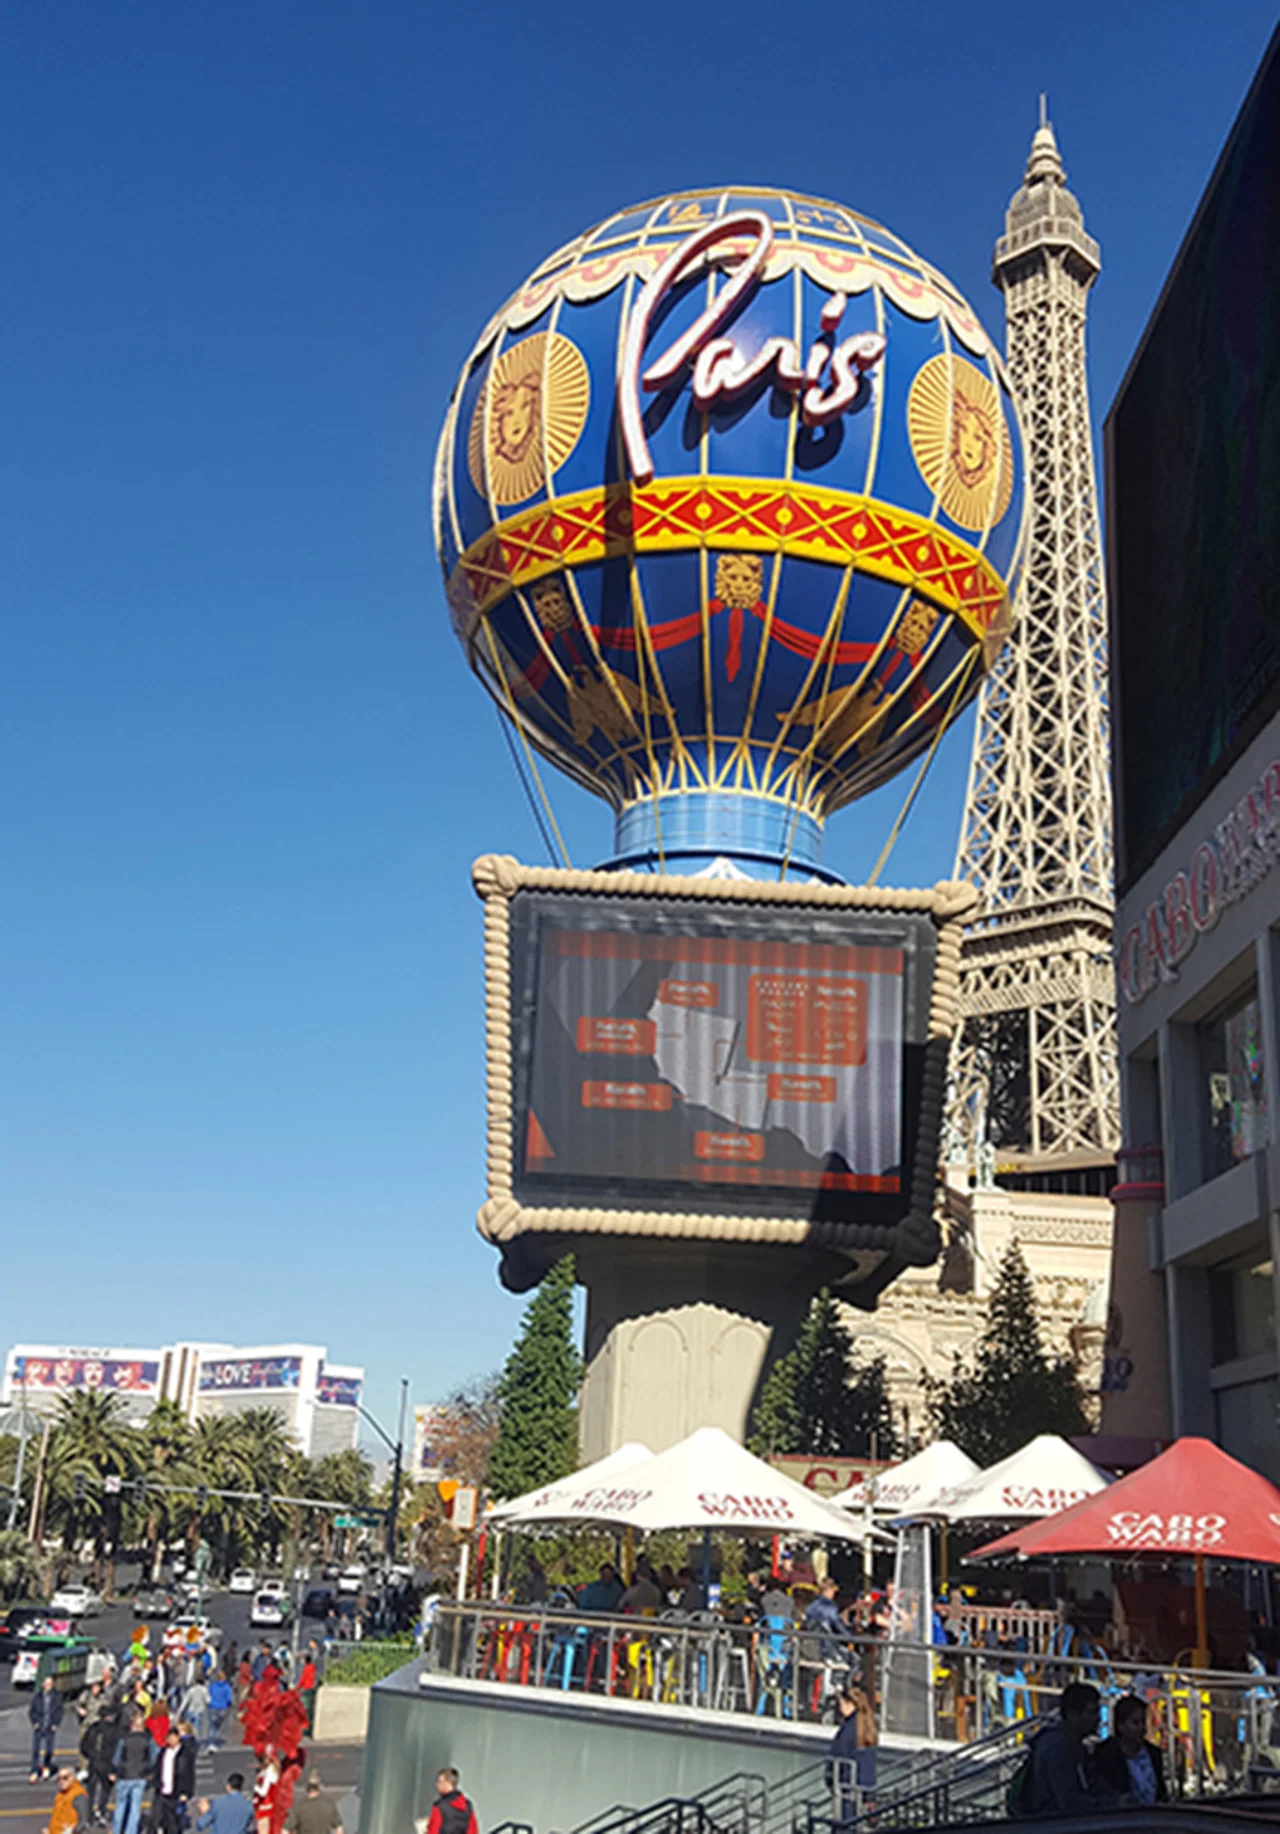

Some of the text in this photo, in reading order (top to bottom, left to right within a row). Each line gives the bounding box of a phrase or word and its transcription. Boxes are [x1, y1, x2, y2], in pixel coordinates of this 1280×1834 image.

[618, 208, 887, 483] Paris
[1121, 842, 1217, 1003] CABO
[215, 1363, 252, 1386] LOVE
[697, 1492, 789, 1508] CABO
[699, 1503, 795, 1523] WABO
[1110, 1511, 1227, 1530] CABO
[1105, 1524, 1223, 1542] WABO
